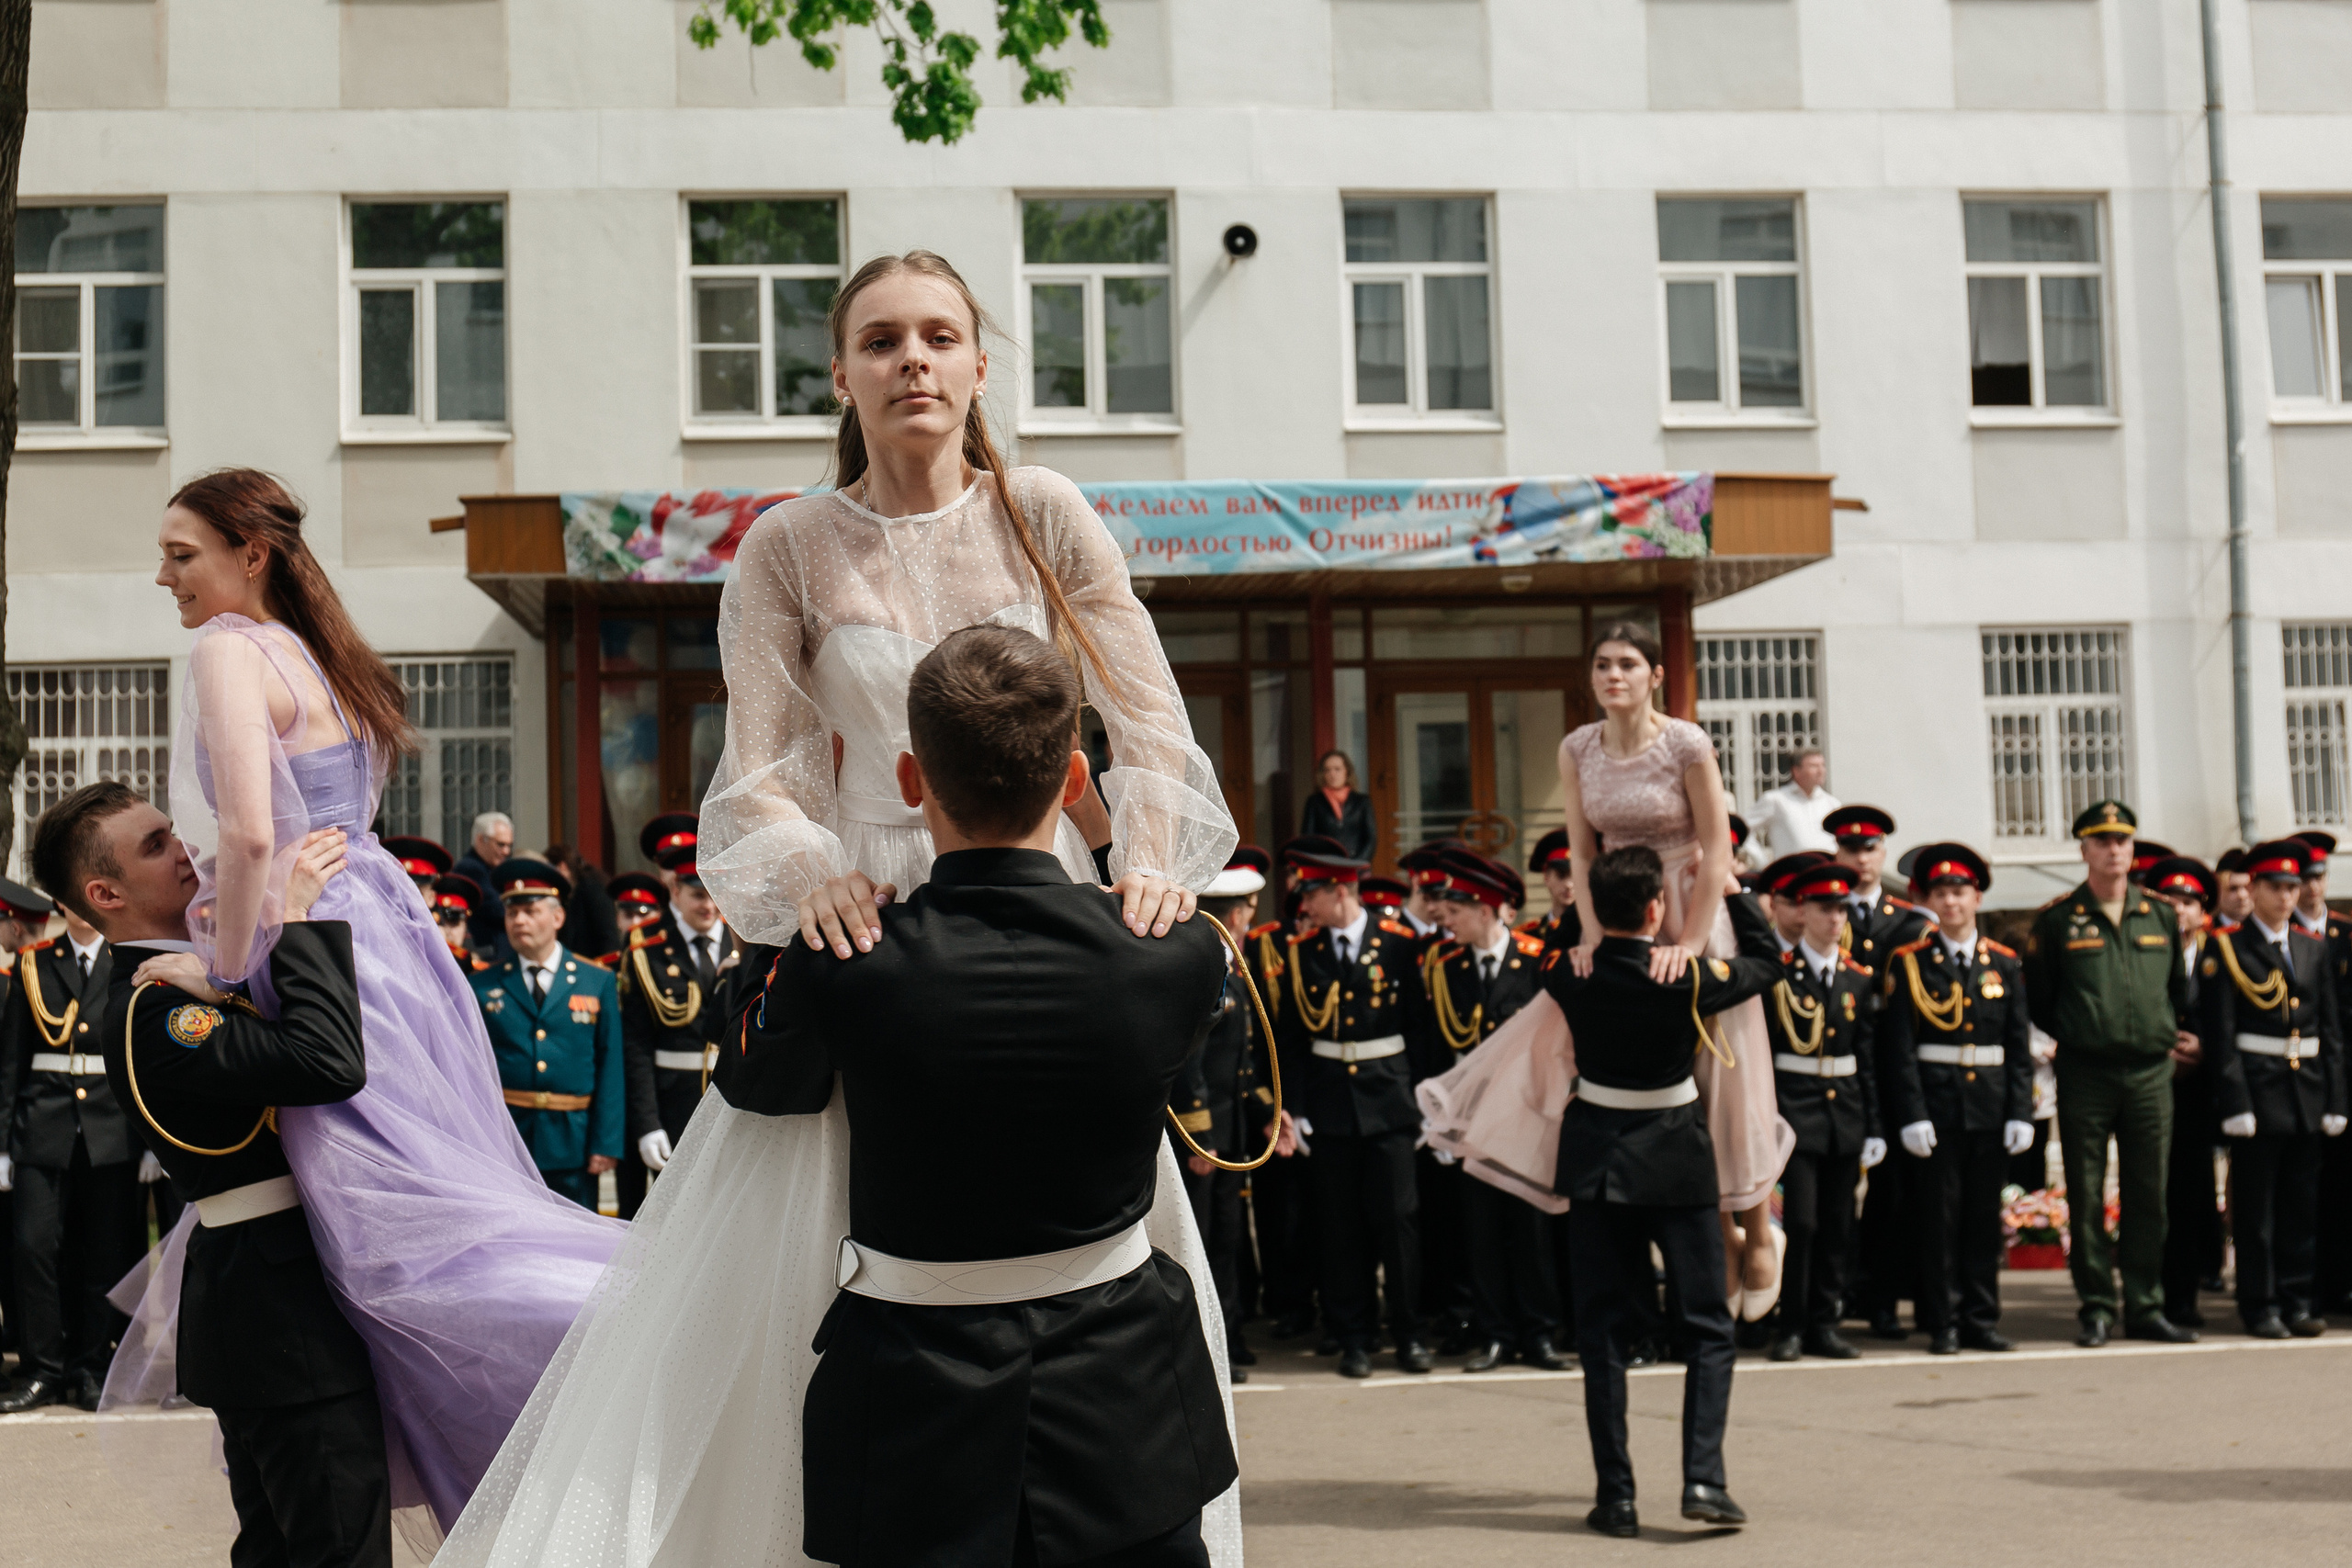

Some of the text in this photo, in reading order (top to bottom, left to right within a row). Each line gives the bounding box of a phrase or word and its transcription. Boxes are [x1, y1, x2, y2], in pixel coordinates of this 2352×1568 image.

[1090, 491, 1483, 521] Желаем вам вперед идти
[1135, 525, 1453, 562] гордостью Отчизны!
